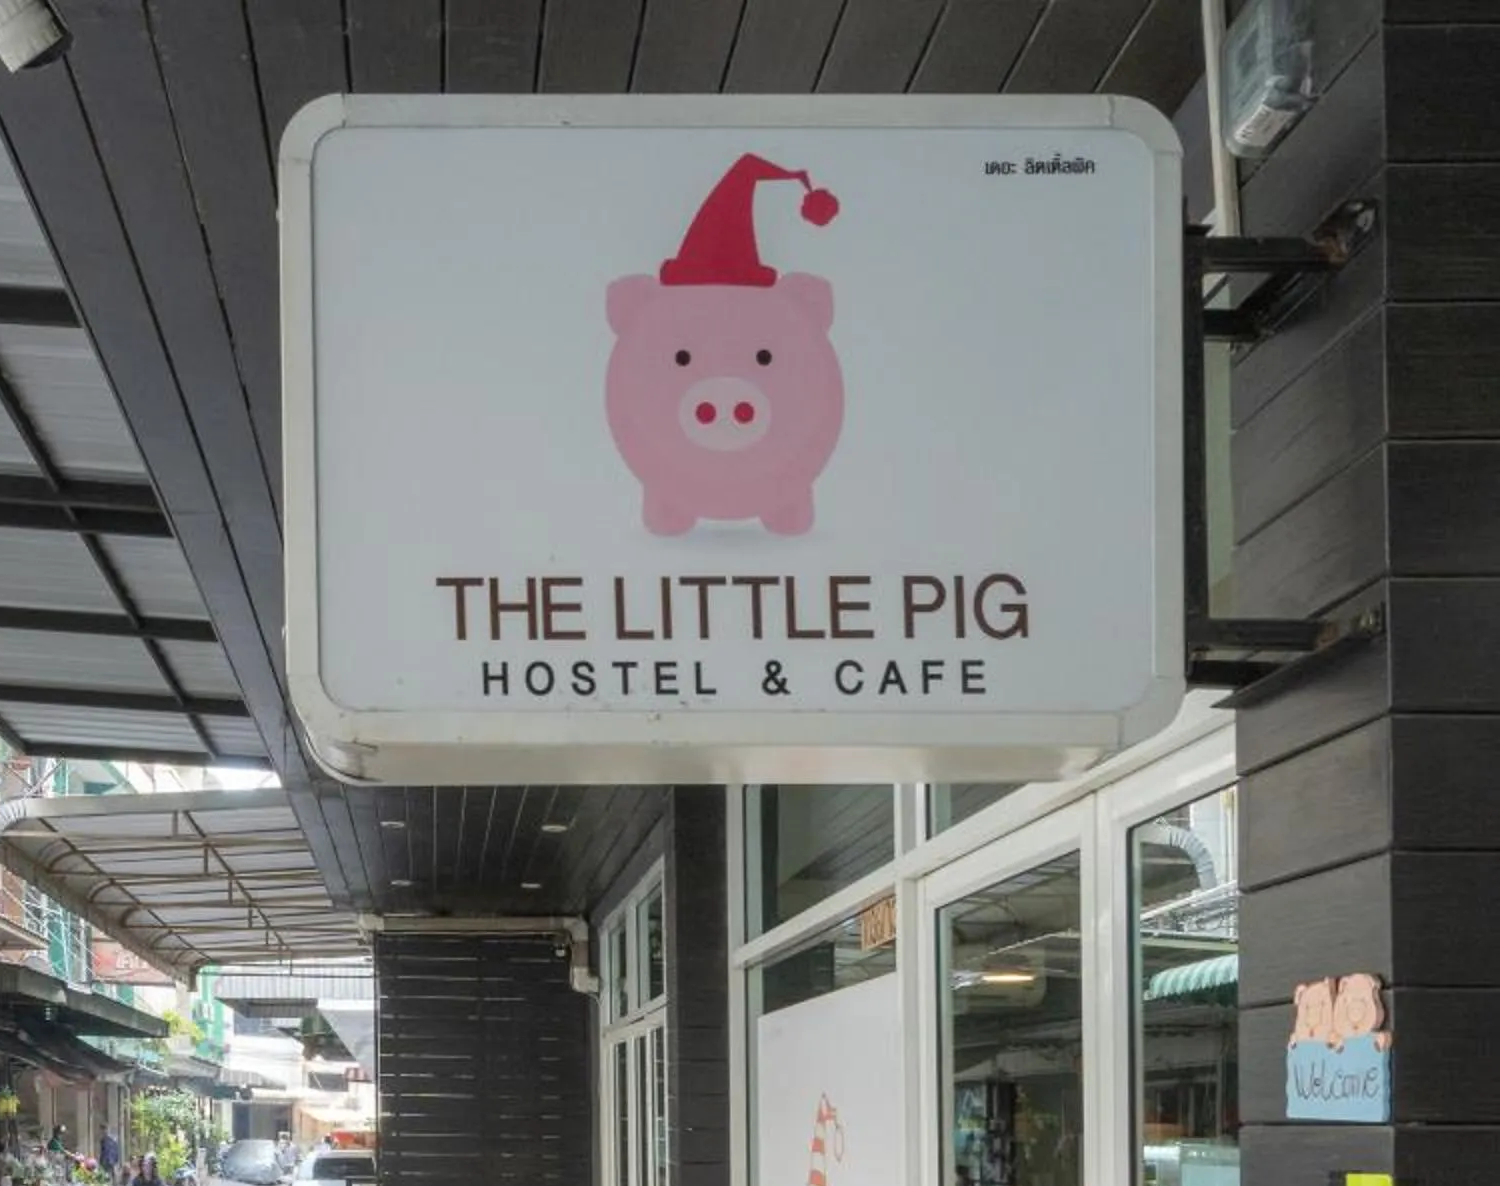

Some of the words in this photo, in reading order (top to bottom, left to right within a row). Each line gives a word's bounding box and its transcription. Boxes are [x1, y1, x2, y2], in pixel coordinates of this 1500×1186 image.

[436, 577, 587, 641] THE
[614, 575, 875, 641] LITTLE
[903, 573, 1030, 640] PIG
[482, 660, 718, 697] HOSTEL
[762, 660, 791, 697] &
[835, 659, 989, 696] CAFE
